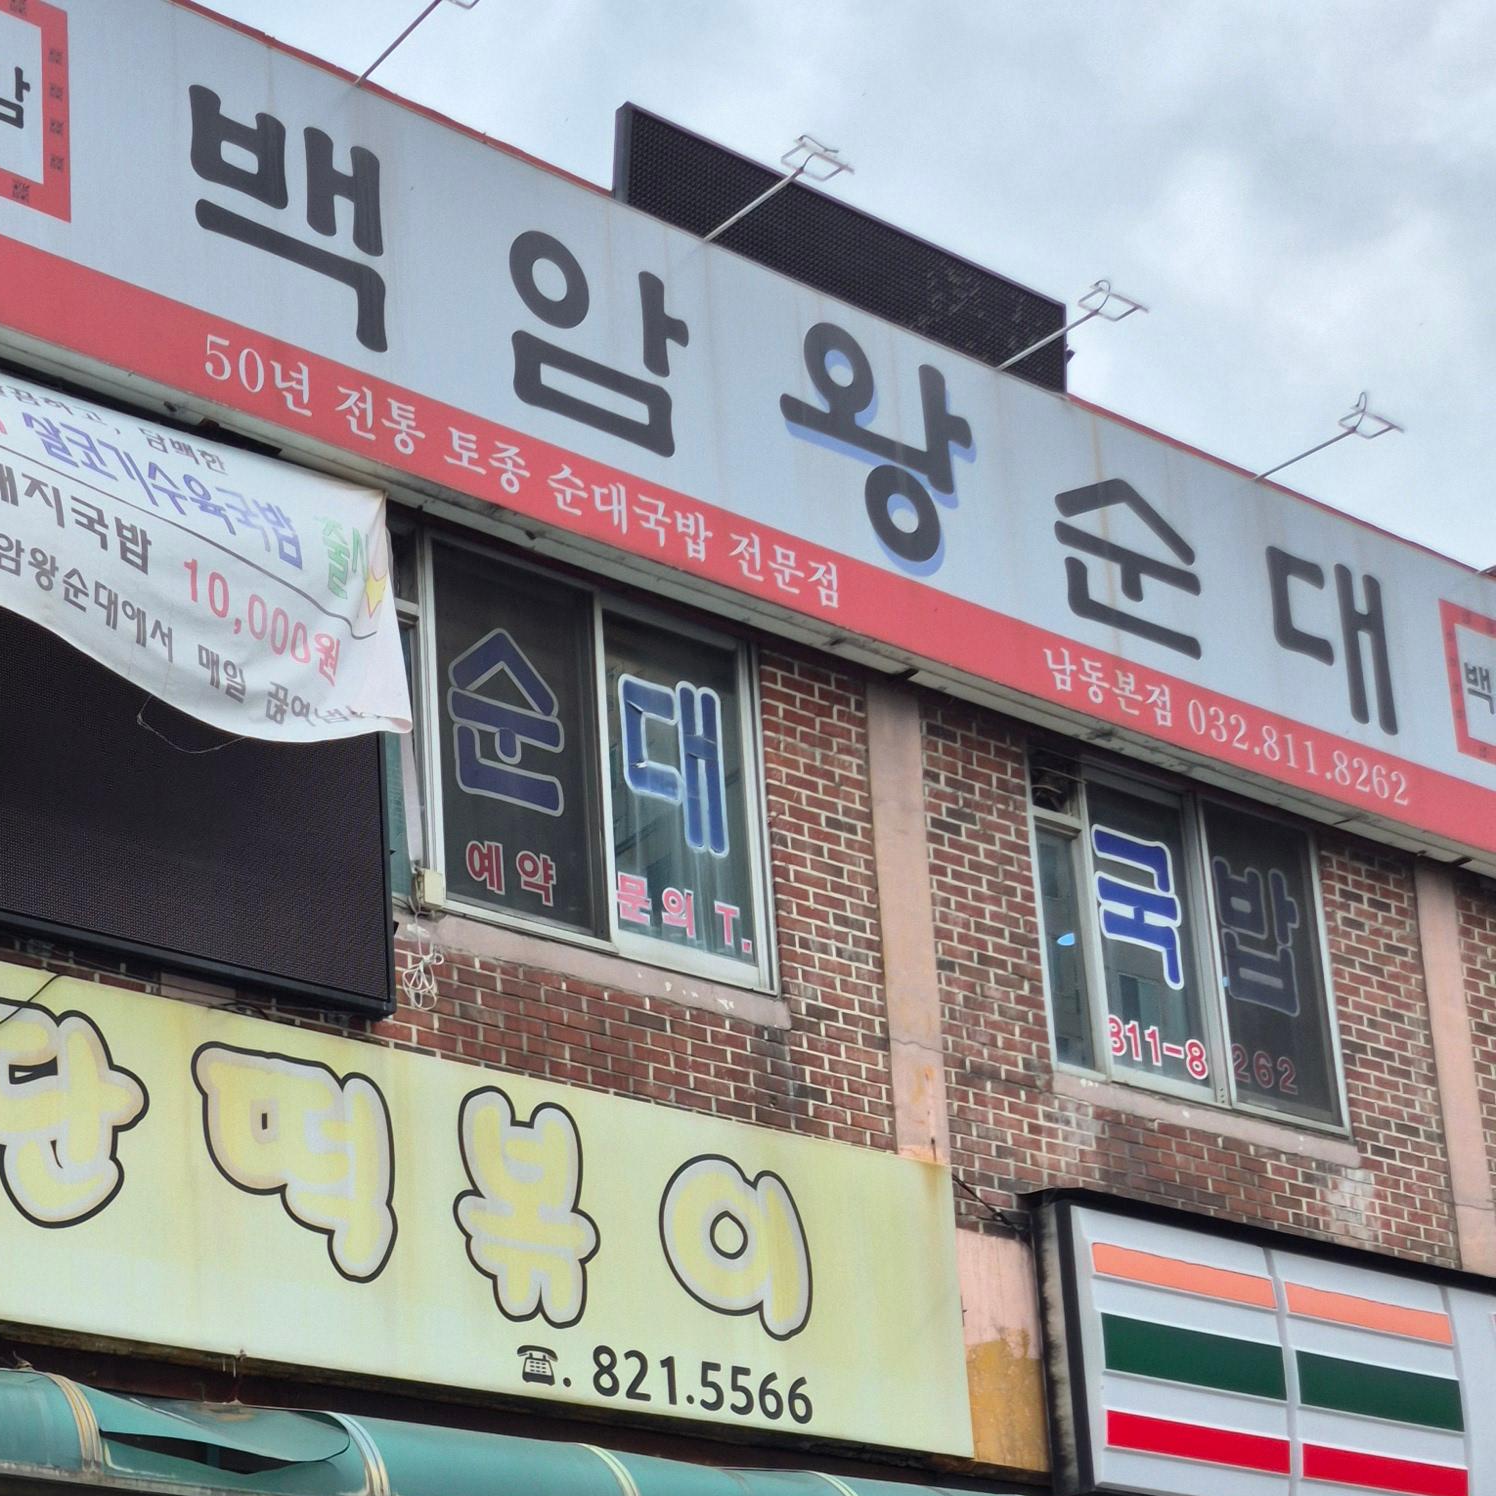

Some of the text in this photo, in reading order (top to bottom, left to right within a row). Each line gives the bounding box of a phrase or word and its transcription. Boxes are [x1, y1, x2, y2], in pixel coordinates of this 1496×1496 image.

[204, 333, 839, 609] 50년 전통 토종 순대국밥 전문점
[184, 558, 341, 687] 10,000원
[198, 644, 247, 704] 매일
[1043, 647, 1409, 806] 남동본점 032.811.8262
[1464, 662, 1495, 715] 백
[466, 840, 753, 953] 예약 문의 T.
[593, 1345, 814, 1425] 821.5566
